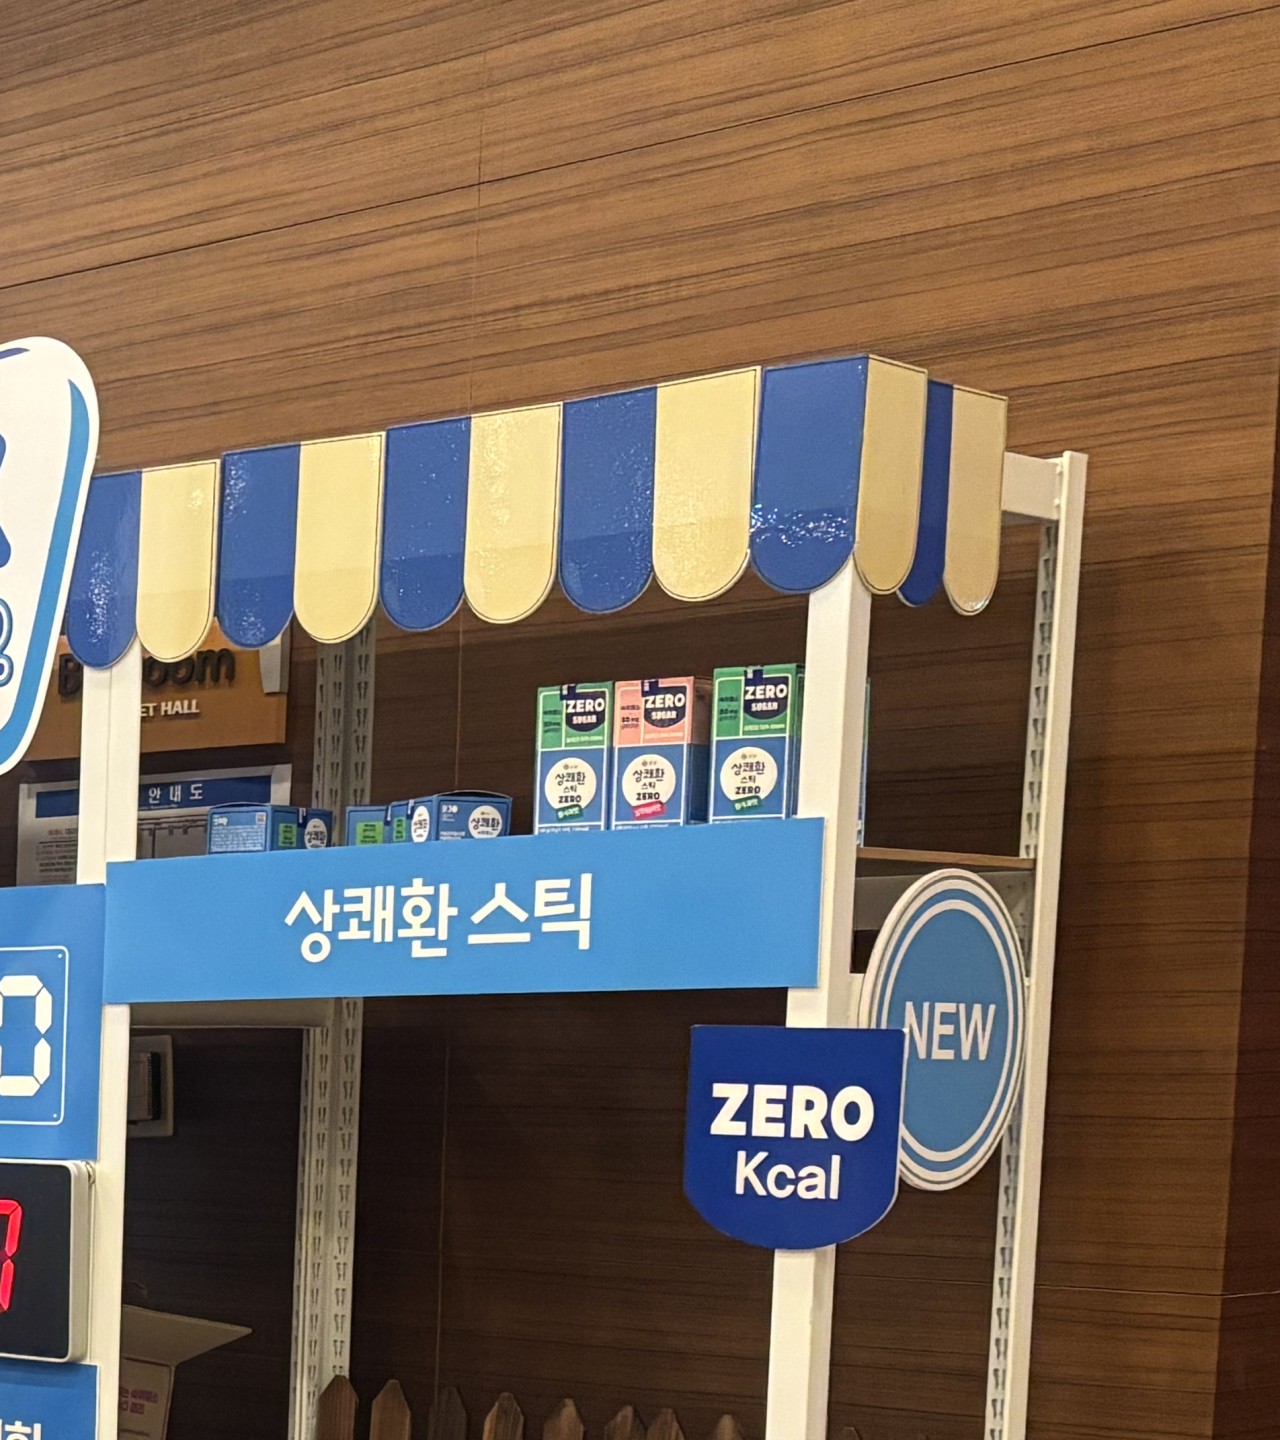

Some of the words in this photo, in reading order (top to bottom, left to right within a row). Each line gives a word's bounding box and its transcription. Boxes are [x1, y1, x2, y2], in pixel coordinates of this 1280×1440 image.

[745, 684, 788, 700] ZERO
[161, 699, 200, 716] HALL
[566, 698, 605, 713] ZERO
[645, 693, 686, 709] ZERO
[650, 710, 677, 721] SUGAR
[633, 767, 665, 783] 상쾌환
[731, 760, 766, 776] 상쾌환
[555, 771, 586, 786] 상쾌환
[641, 780, 656, 790] 스틱
[740, 774, 756, 784] 스틱
[563, 784, 578, 793] 스틱
[636, 791, 661, 801] ZERO
[735, 786, 761, 795] ZERO
[558, 795, 582, 804] ZERO
[284, 876, 458, 963] 상쾌환
[467, 872, 595, 951] 스틱
[905, 1000, 997, 1062] NEW
[709, 1082, 876, 1143] ZERO
[734, 1149, 842, 1201] Kcal
